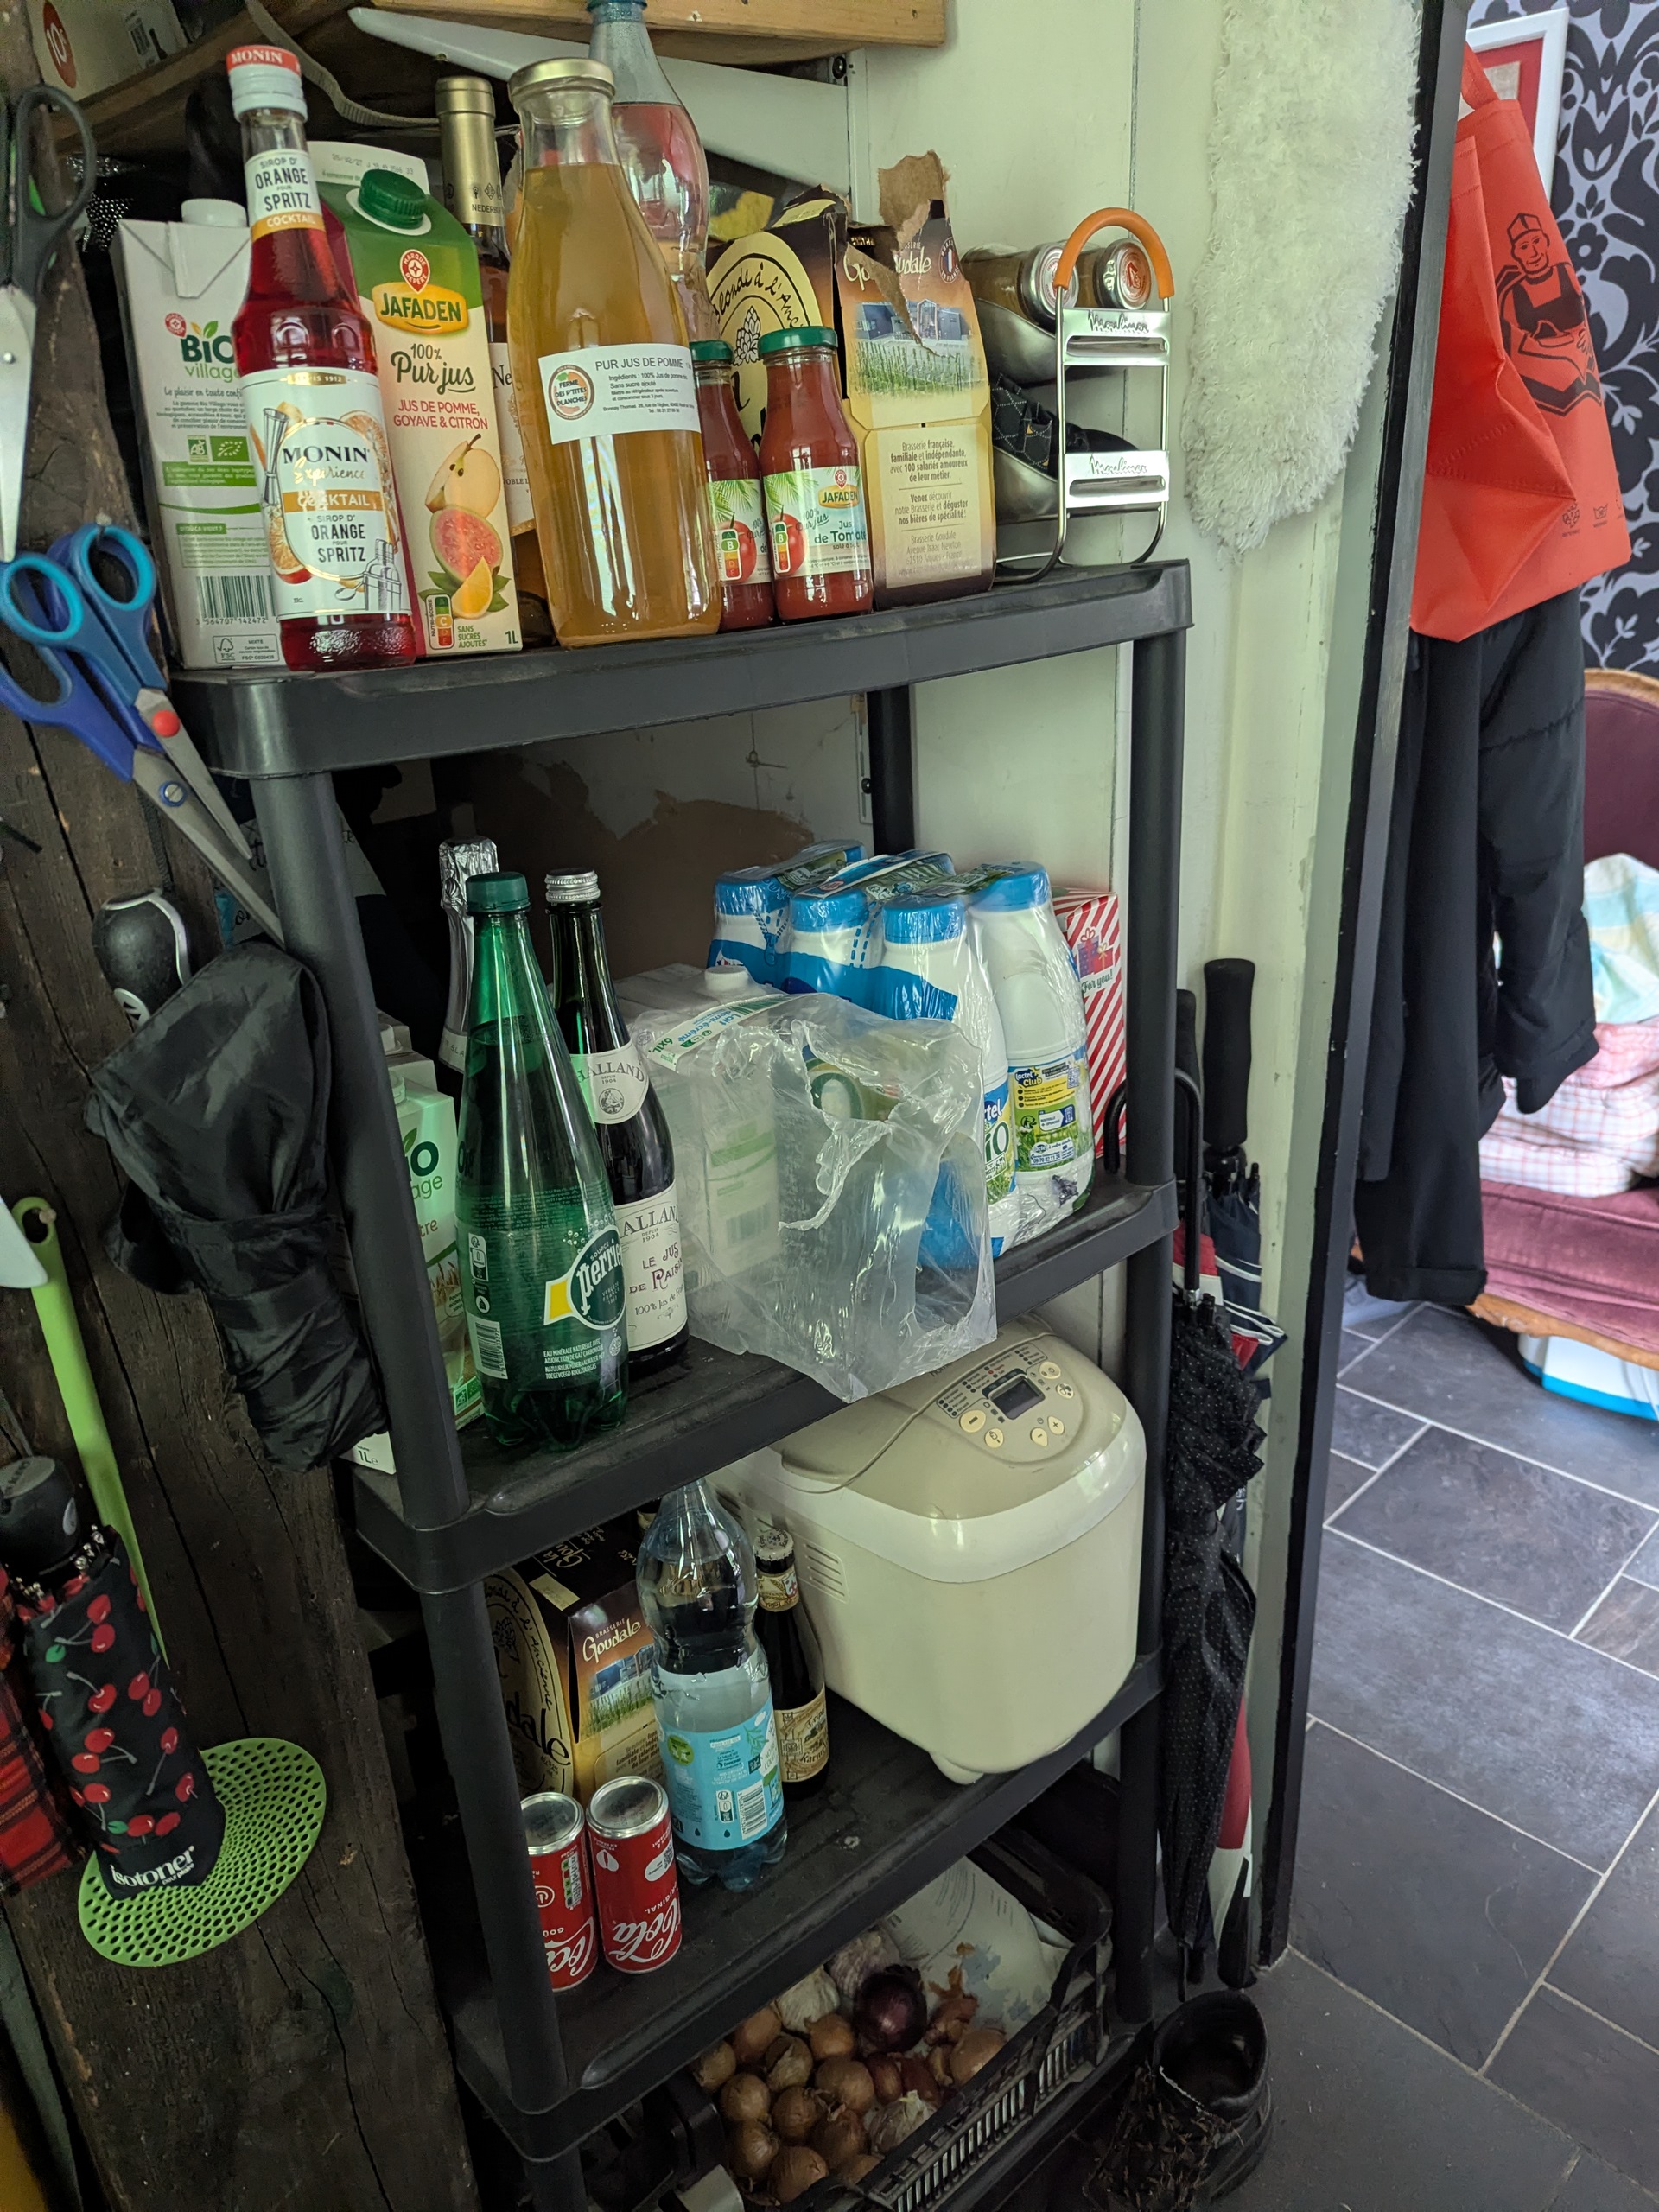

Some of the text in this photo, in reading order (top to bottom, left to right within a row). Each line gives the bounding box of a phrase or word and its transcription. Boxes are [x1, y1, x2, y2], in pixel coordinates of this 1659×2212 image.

[232, 50, 283, 64] MONIN
[260, 157, 286, 169] SIROP
[255, 168, 308, 189] ORANGE
[264, 192, 311, 212] SPRITZ
[266, 213, 316, 227] COCKTAIL
[404, 252, 427, 265] MARQUE
[380, 293, 462, 322] JAFADEN
[1088, 309, 1149, 333] Moulinex
[410, 343, 442, 360] 100%
[595, 357, 683, 371] PUR JUS DE POMME
[391, 351, 474, 395] Pur jus
[559, 379, 579, 388] FERME
[555, 386, 588, 398] DES P'TITES
[398, 400, 480, 416] JUS DE POMME,
[557, 396, 588, 406] PLANCHES
[394, 415, 488, 429] GOYAVE & CITRON
[902, 441, 926, 451] Brasserie
[283, 445, 369, 464] MONIN
[891, 451, 917, 462] familiale
[918, 452, 925, 461] et
[905, 464, 916, 473] 100
[917, 461, 938, 471] salariés
[940, 460, 968, 469] amoureux
[1090, 454, 1147, 474] Moulinex
[909, 474, 917, 482] de
[918, 473, 930, 481] leur
[297, 493, 370, 508] COCKTAIL
[822, 491, 858, 503] JAFADEN
[911, 494, 927, 504] Venez
[894, 505, 909, 515] notre
[911, 503, 935, 513] Brasserie
[943, 499, 969, 512] déguster
[838, 520, 853, 529] Jus
[899, 517, 909, 525] nos
[910, 514, 928, 524] bières
[312, 524, 366, 540] ORANGE
[778, 534, 784, 543] B
[911, 534, 934, 544] Brasserie
[728, 541, 734, 550] B
[814, 535, 829, 544] de
[317, 547, 366, 563] SPRITZ
[428, 599, 436, 637] NUTRI-SCORE
[439, 617, 448, 626] C
[505, 631, 518, 645] 1L
[1082, 969, 1113, 993] For you!
[1015, 1071, 1033, 1081] lactel
[1023, 1076, 1042, 1087] Club
[642, 1227, 659, 1237] DEPUIS
[642, 1233, 659, 1243] 1904
[590, 1243, 609, 1261] SOURCE
[642, 1242, 679, 1270] LE JUS
[629, 1283, 647, 1294] DE
[635, 1306, 657, 1315] 100%
[658, 1300, 668, 1310] Jus
[543, 1349, 553, 1357] EAU
[553, 1346, 572, 1356] MINÉRALE
[573, 1342, 592, 1352] NATURELLE
[544, 1354, 569, 1364] ADJONCTION
[583, 1344, 604, 1357] CARBONIQUE
[359, 1450, 371, 1463] 1L
[595, 1618, 625, 1638] BRASSERIE
[582, 1618, 641, 1663] Goudale
[111, 1850, 193, 1886] isotoner
[609, 1898, 680, 1963] Cola
